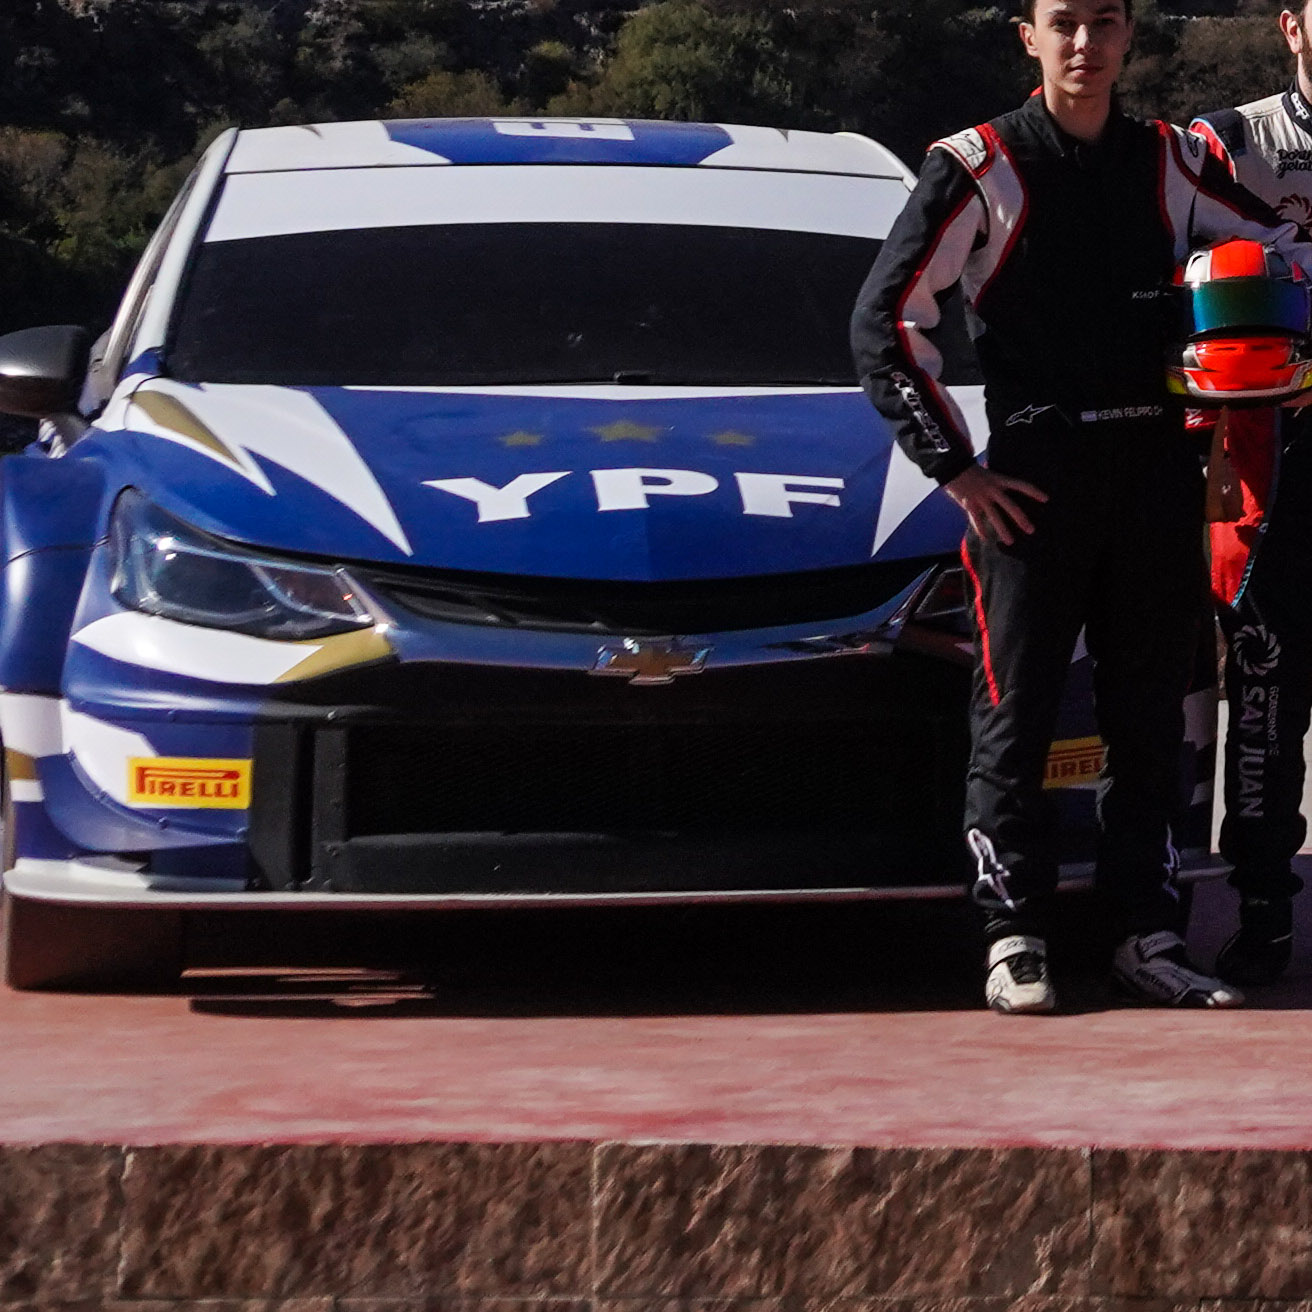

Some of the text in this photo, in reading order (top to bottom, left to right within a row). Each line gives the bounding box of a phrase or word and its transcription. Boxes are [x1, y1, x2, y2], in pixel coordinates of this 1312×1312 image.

[420, 467, 846, 523] YPF
[136, 766, 241, 798] PIRELLI
[1237, 743, 1267, 818] JUAN
